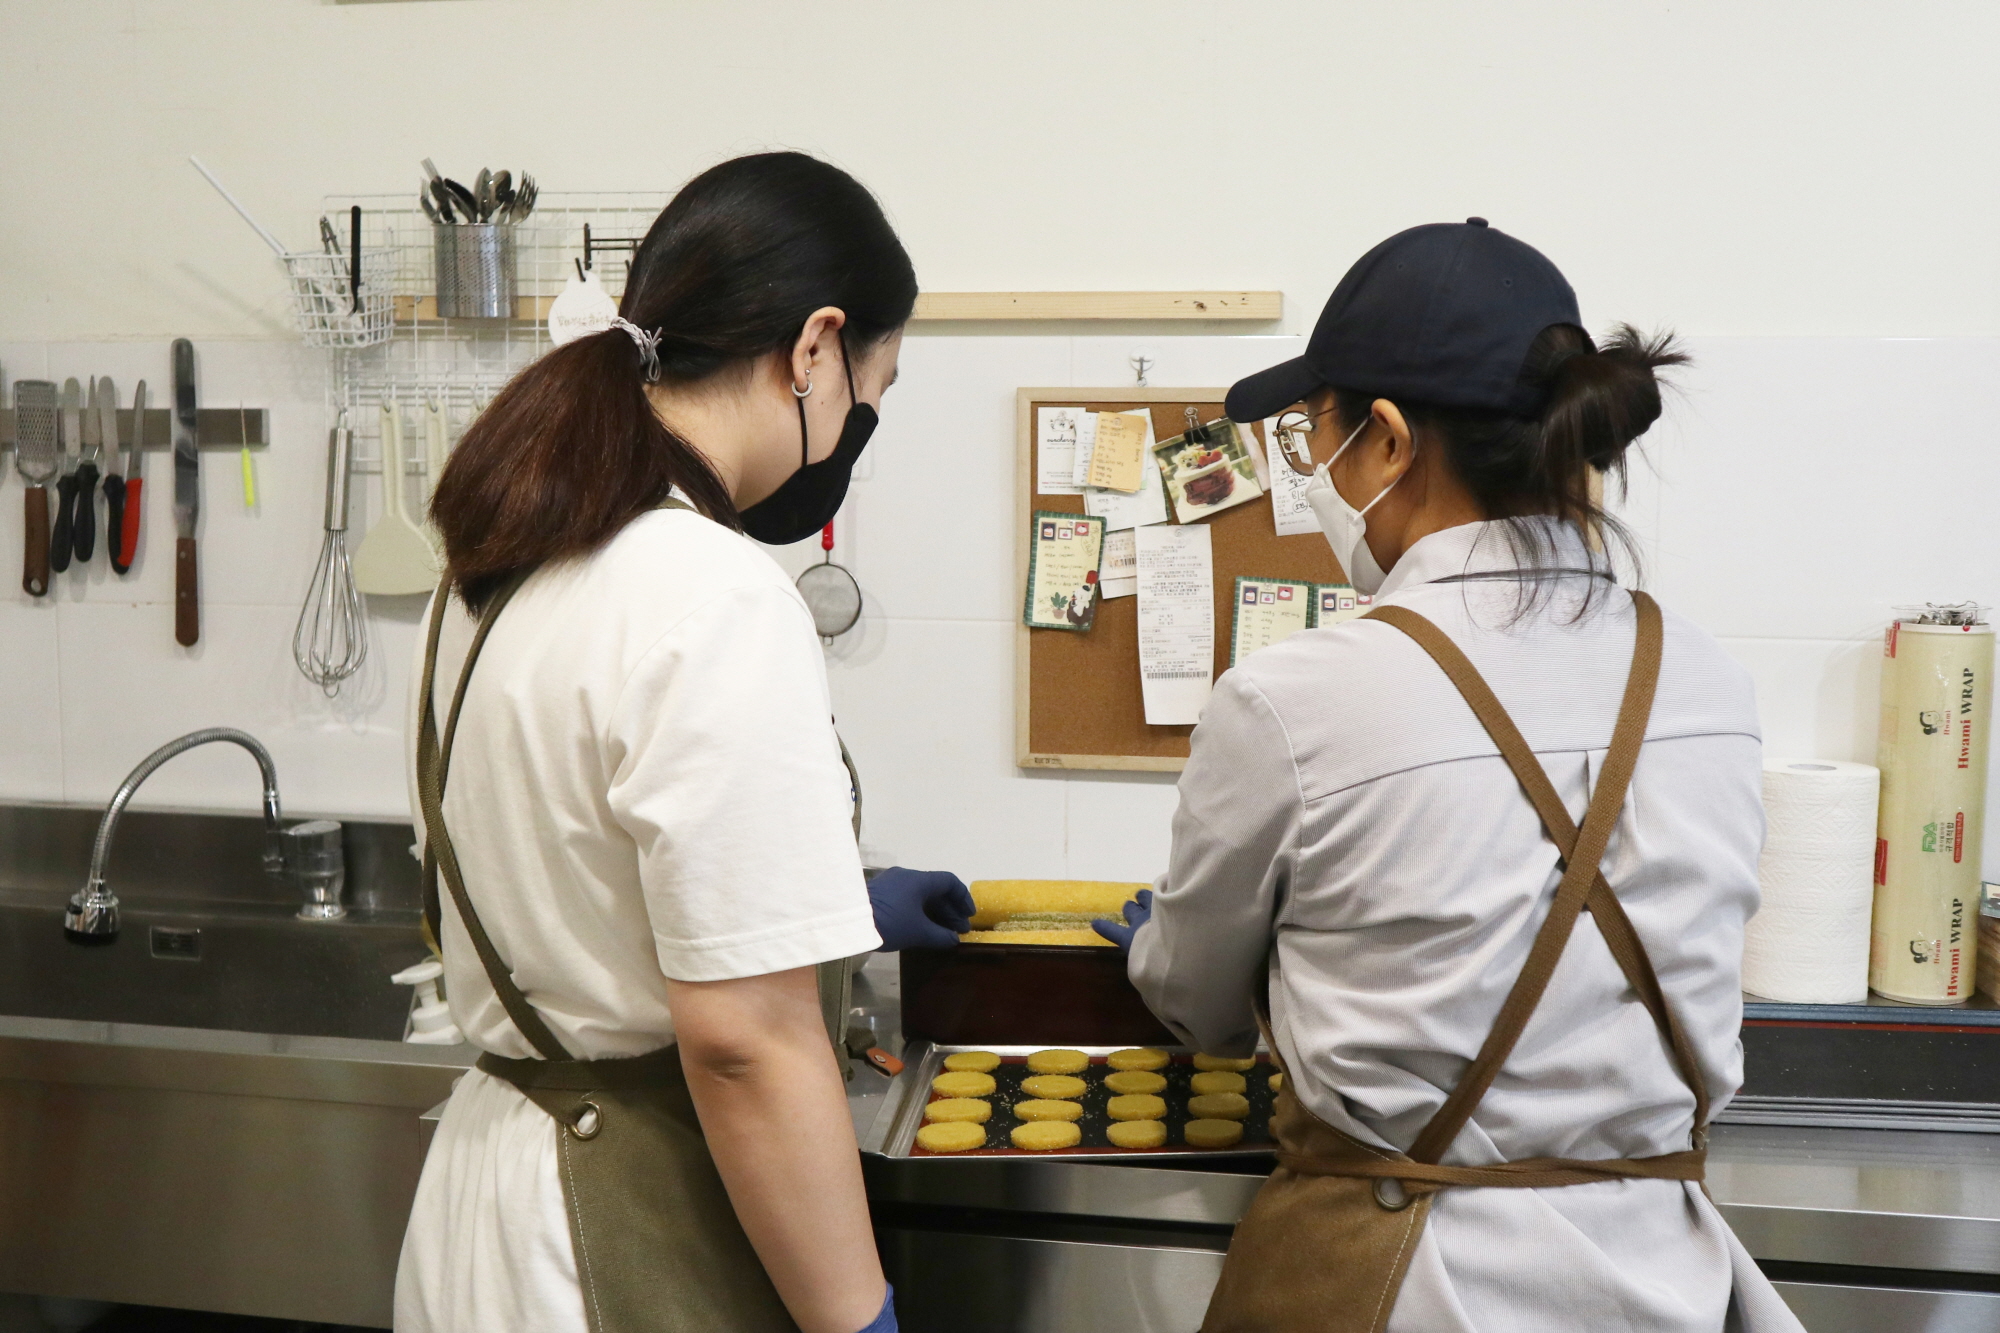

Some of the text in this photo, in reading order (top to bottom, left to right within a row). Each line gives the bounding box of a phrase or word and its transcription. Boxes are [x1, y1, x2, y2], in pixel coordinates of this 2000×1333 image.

[1957, 668, 1974, 769] Hwami WRAP
[1922, 822, 1938, 852] FDA
[1933, 939, 1941, 964] Hwami
[1947, 898, 1963, 997] Hwami WRAP
